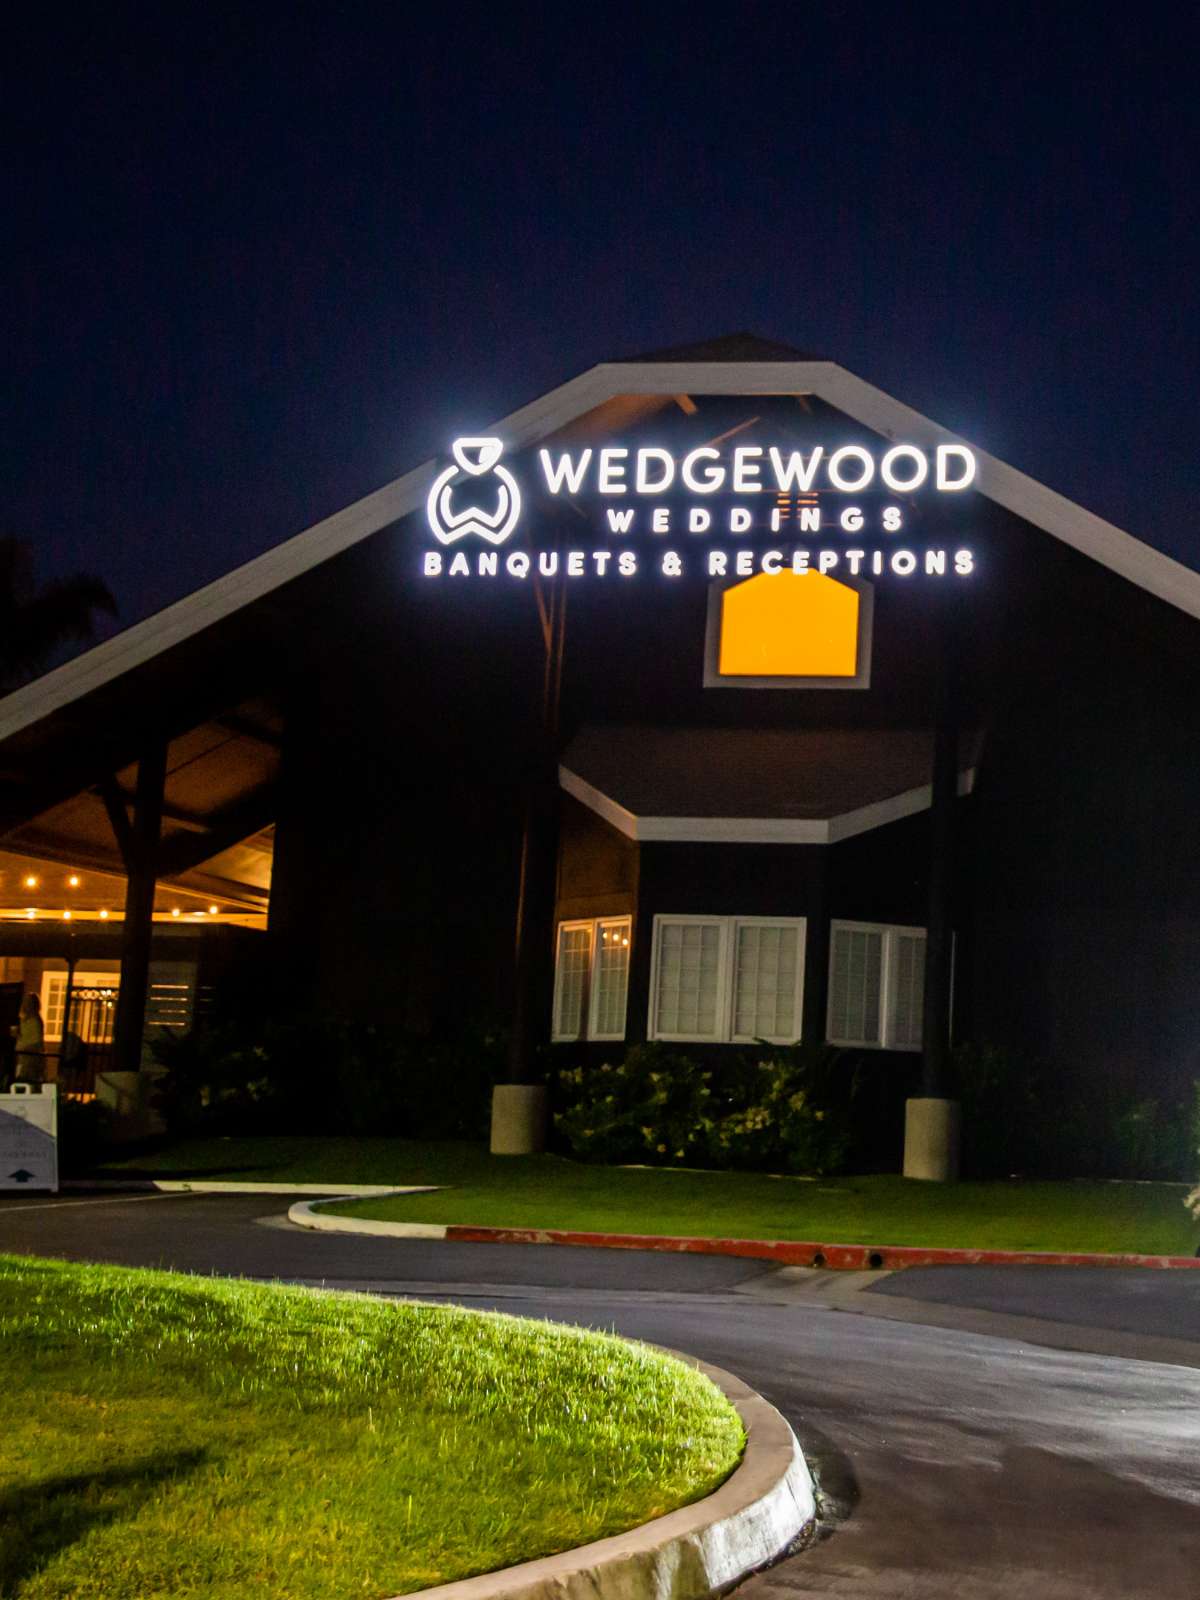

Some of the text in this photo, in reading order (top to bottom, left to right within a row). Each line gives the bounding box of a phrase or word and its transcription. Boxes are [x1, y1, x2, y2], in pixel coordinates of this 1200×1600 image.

[539, 444, 977, 495] WEDGEWOOD
[606, 506, 904, 534] WEDDINGS
[422, 550, 975, 578] BANQUETS & RECEPTIONS
